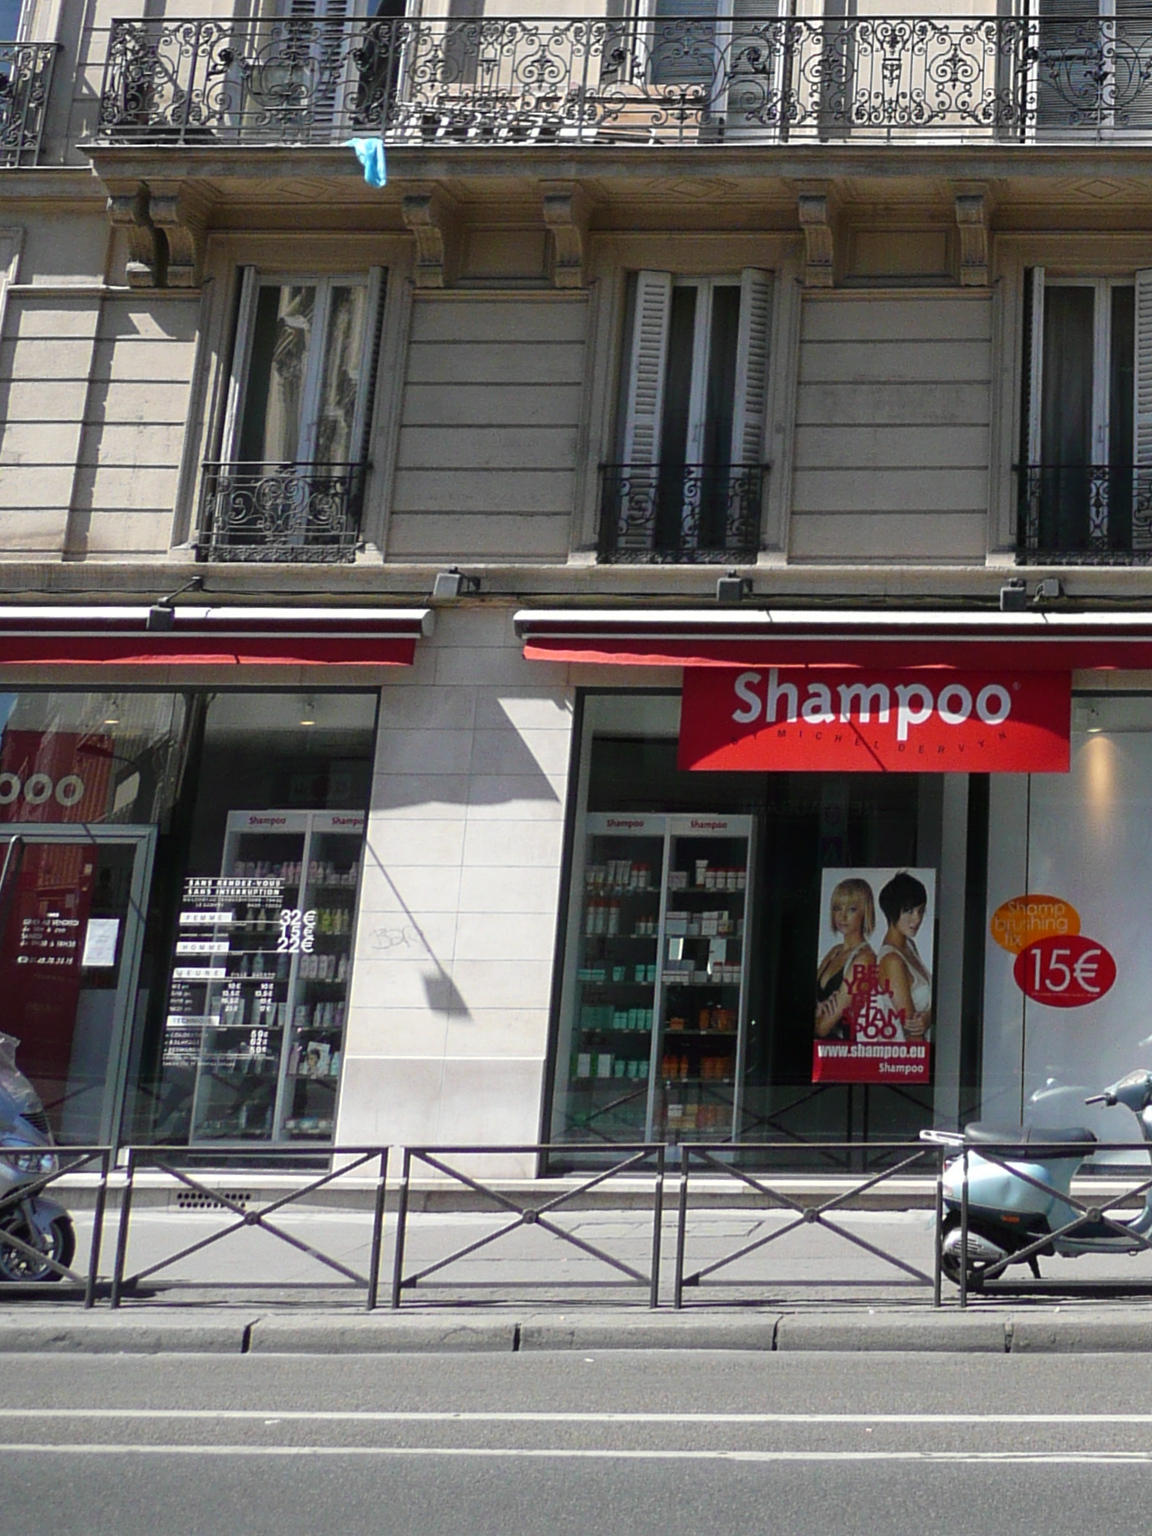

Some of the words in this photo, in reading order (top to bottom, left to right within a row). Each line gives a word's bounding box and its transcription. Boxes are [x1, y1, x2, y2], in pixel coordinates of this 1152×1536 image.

[731, 667, 1012, 742] Shampoo
[777, 729, 881, 751] MICHEL
[896, 730, 1008, 754] DERVYN
[248, 816, 287, 828] Shampoo
[606, 817, 645, 829] Shampoo
[690, 819, 728, 830] Shampoo
[188, 879, 213, 887] SANS
[216, 879, 281, 887] RENDEZ-VOUS
[187, 888, 212, 896] SANS
[215, 888, 280, 896] INTERRUPTION
[279, 909, 317, 926] 32€
[1007, 901, 1065, 918] Shamp
[276, 937, 315, 953] 22€
[1004, 931, 1022, 946] fix
[853, 964, 879, 981] BE
[1030, 949, 1101, 993] 15€
[842, 1008, 906, 1026] SHAM
[850, 1024, 897, 1042] POO
[817, 1044, 926, 1060] www.shampoo.eu
[878, 1062, 925, 1075] Shampoo
